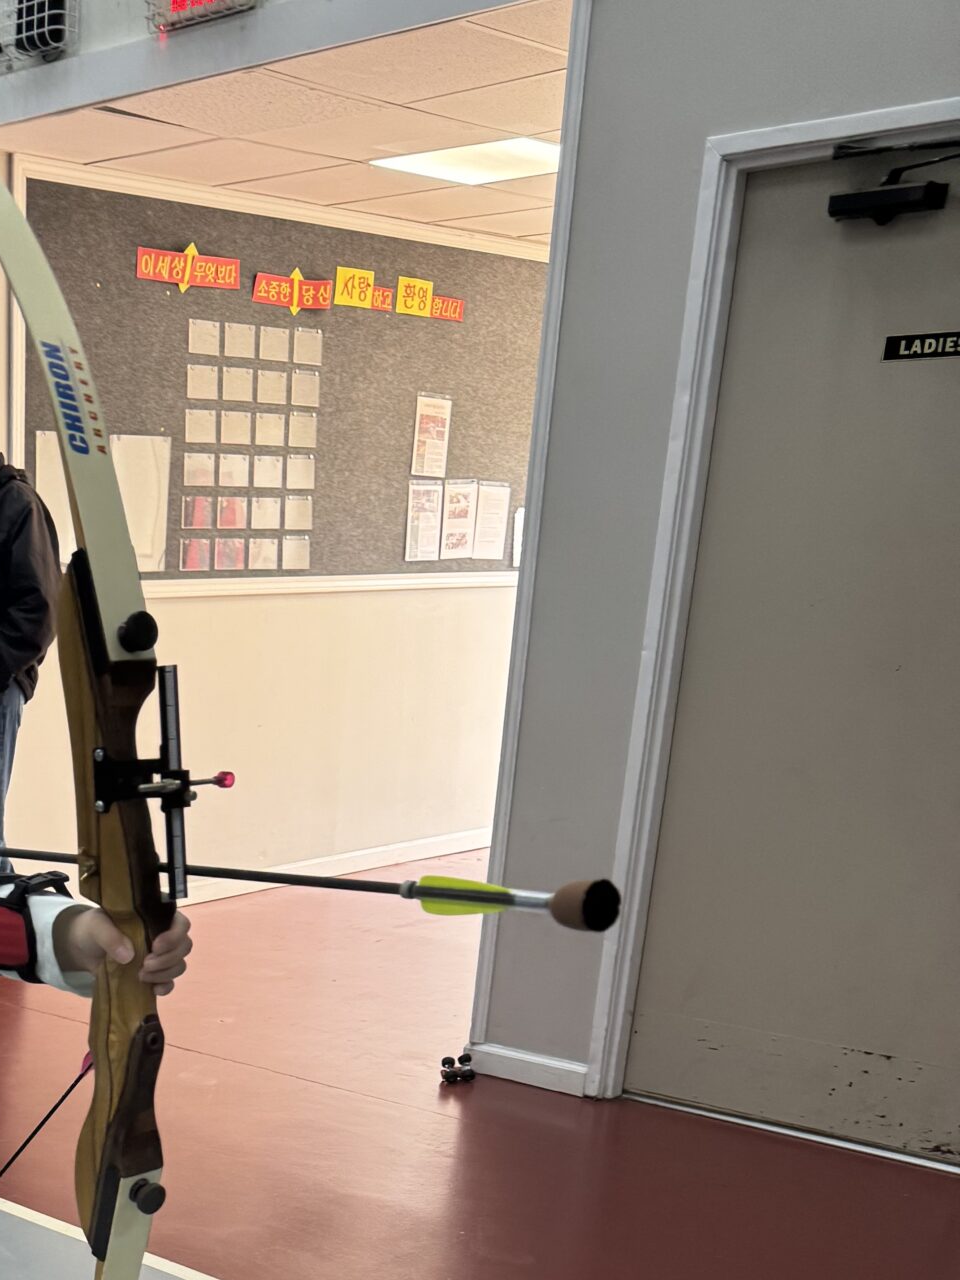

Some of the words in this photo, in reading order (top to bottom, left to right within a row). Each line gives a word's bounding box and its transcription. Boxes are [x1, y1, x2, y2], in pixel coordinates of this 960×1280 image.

[193, 262, 236, 285] 무엇보다
[257, 279, 292, 303] 소중한
[301, 284, 331, 306] 당신
[899, 336, 960, 355] LADIE
[41, 341, 90, 455] CHIRON
[68, 346, 107, 455] ARCHERY
